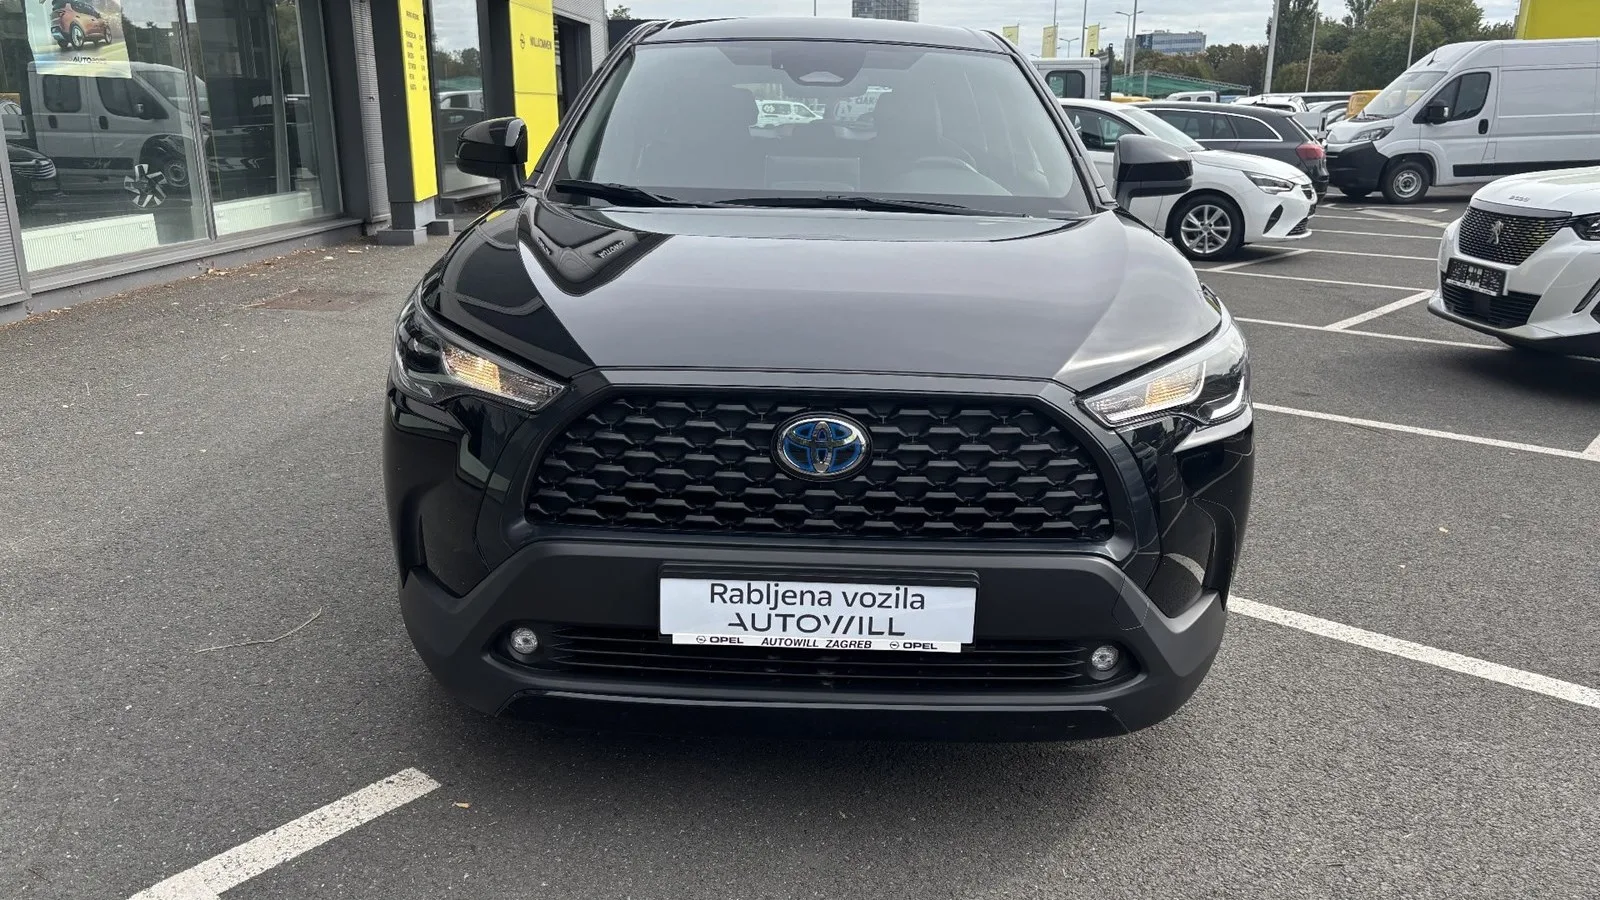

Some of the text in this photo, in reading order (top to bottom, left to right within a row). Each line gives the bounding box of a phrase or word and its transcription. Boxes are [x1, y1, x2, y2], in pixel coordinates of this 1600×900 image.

[710, 582, 925, 611] Rabljena vozila
[728, 612, 905, 636] AUTOWILL
[709, 636, 938, 650] OPEL AUTOWILL ZAGREB OPEL
